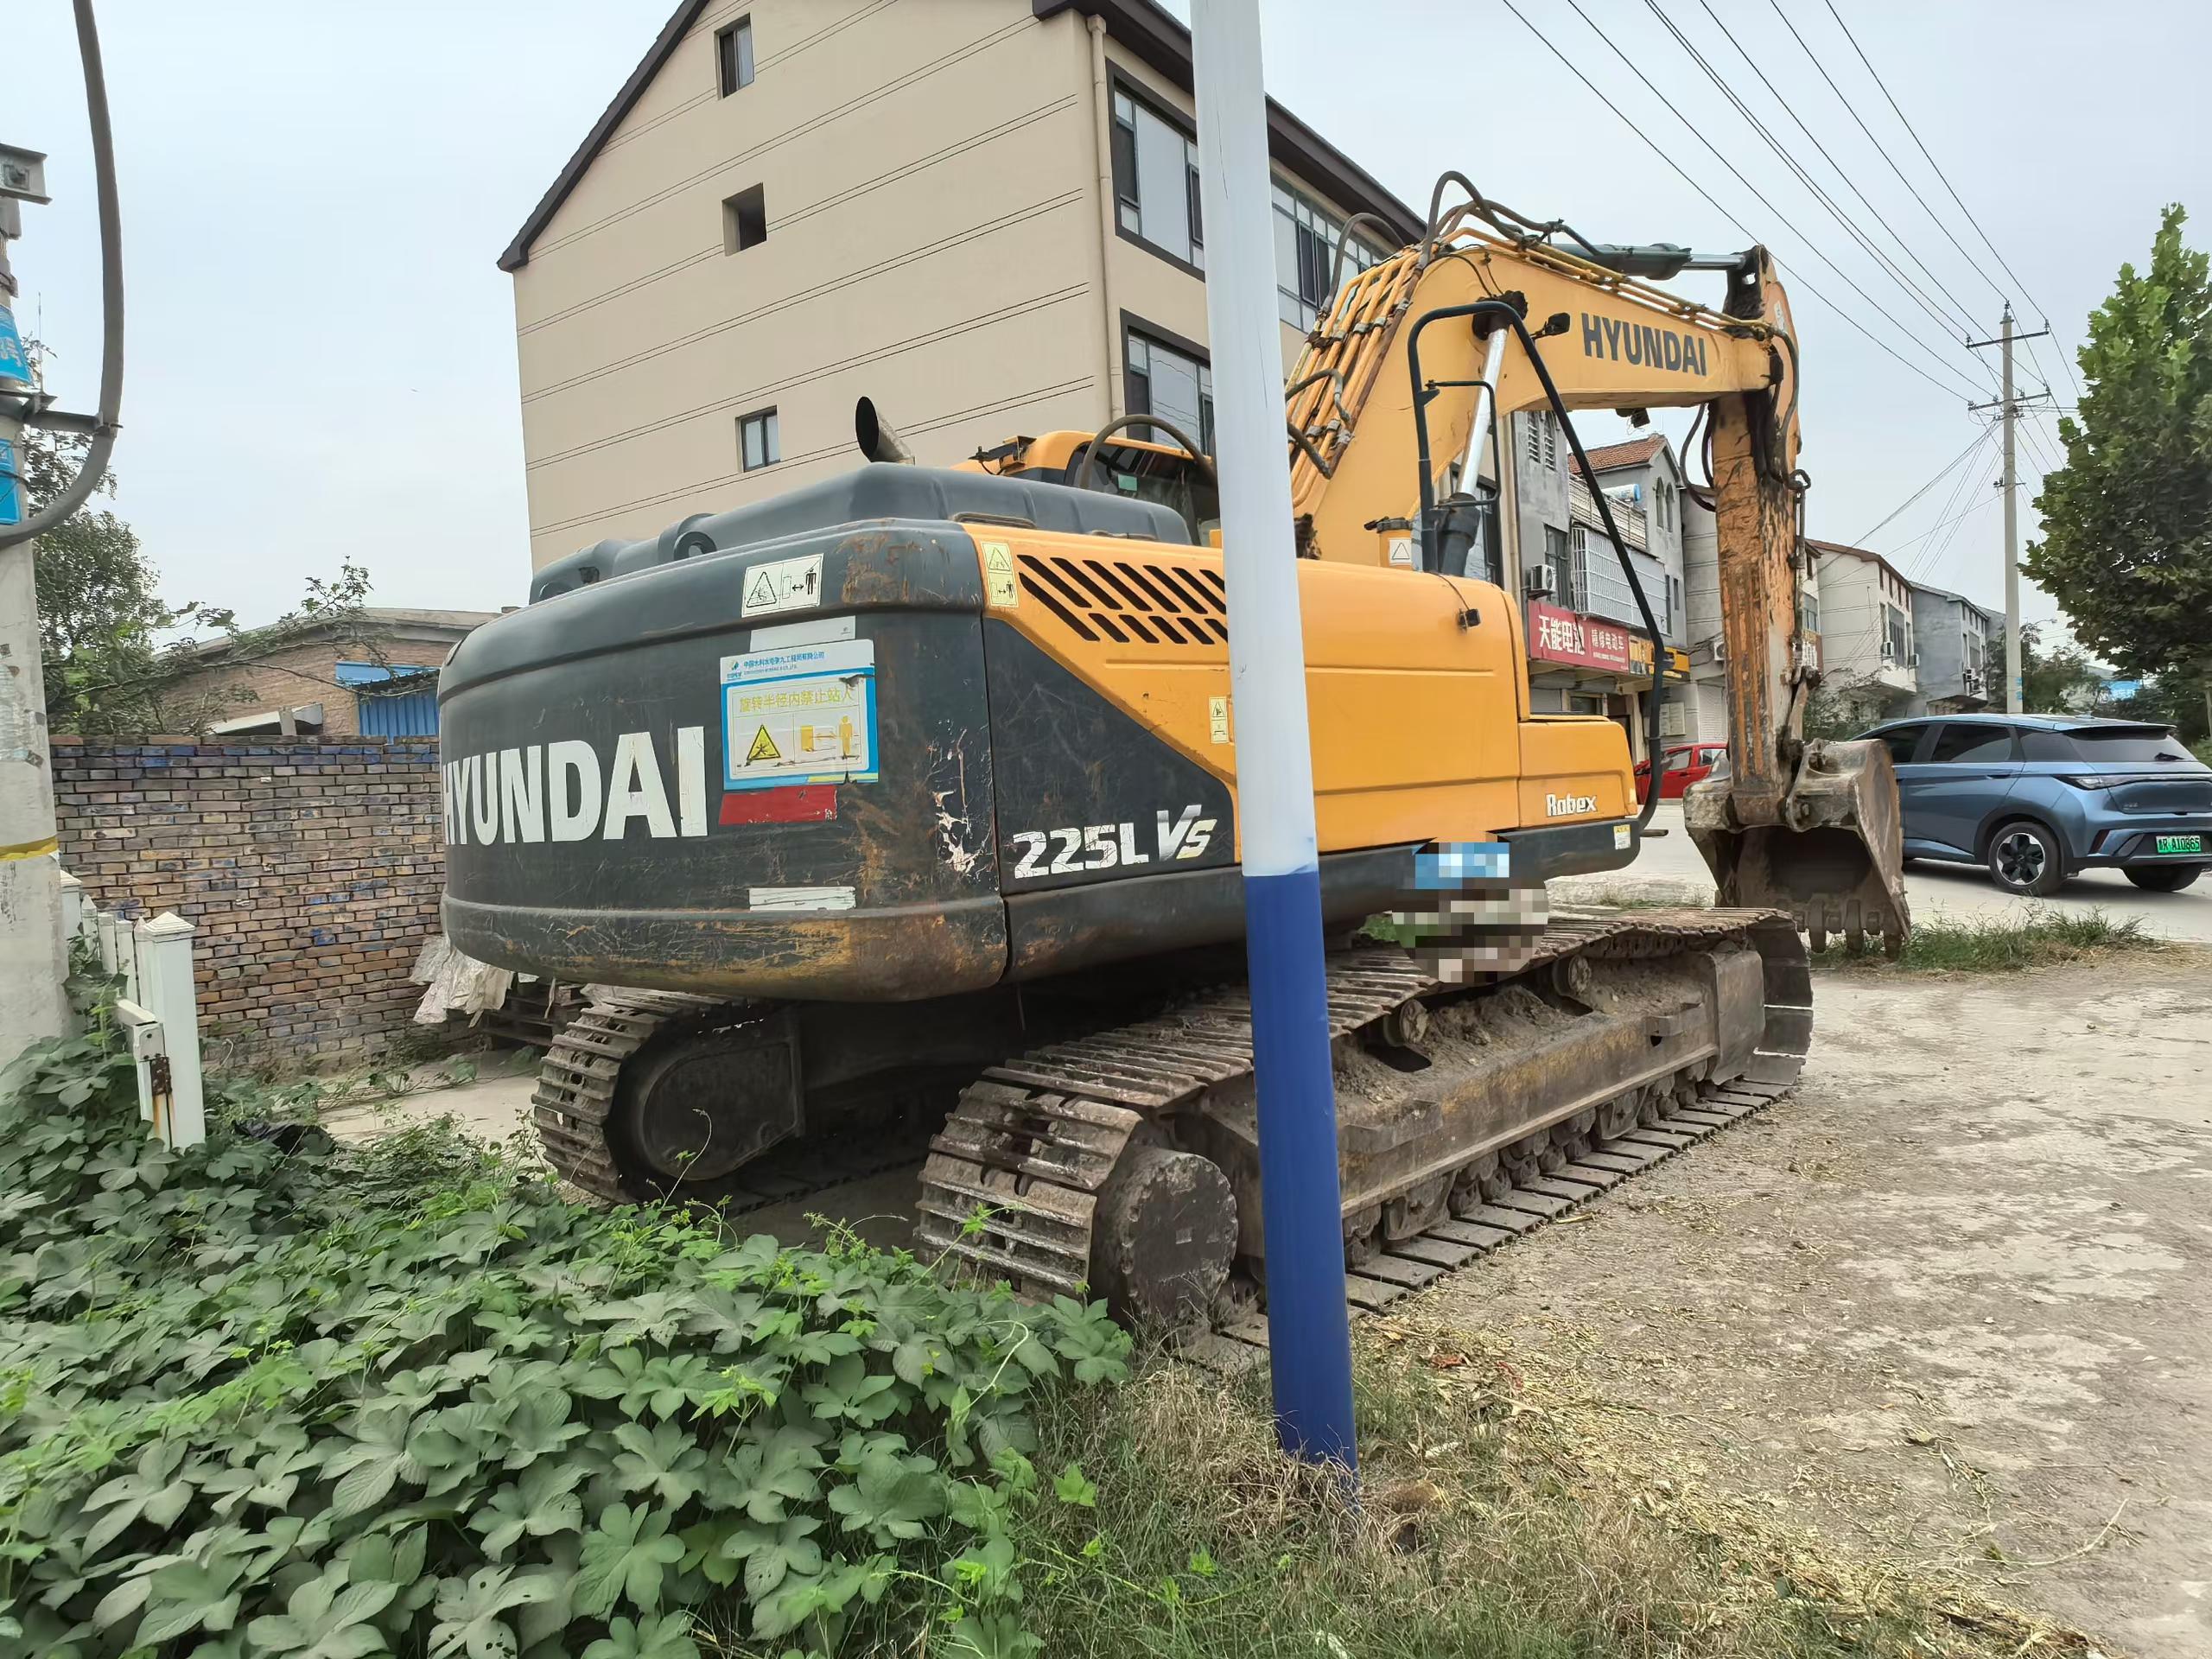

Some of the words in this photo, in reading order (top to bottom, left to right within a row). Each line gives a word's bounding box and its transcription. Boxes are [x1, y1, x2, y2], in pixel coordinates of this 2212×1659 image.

[1581, 312, 1707, 376] HYUNDAI
[1538, 614, 1586, 656] 天能电池
[443, 726, 708, 846] HYUNDAI
[1546, 792, 1598, 817] Robex
[1013, 823, 1149, 879] 225L
